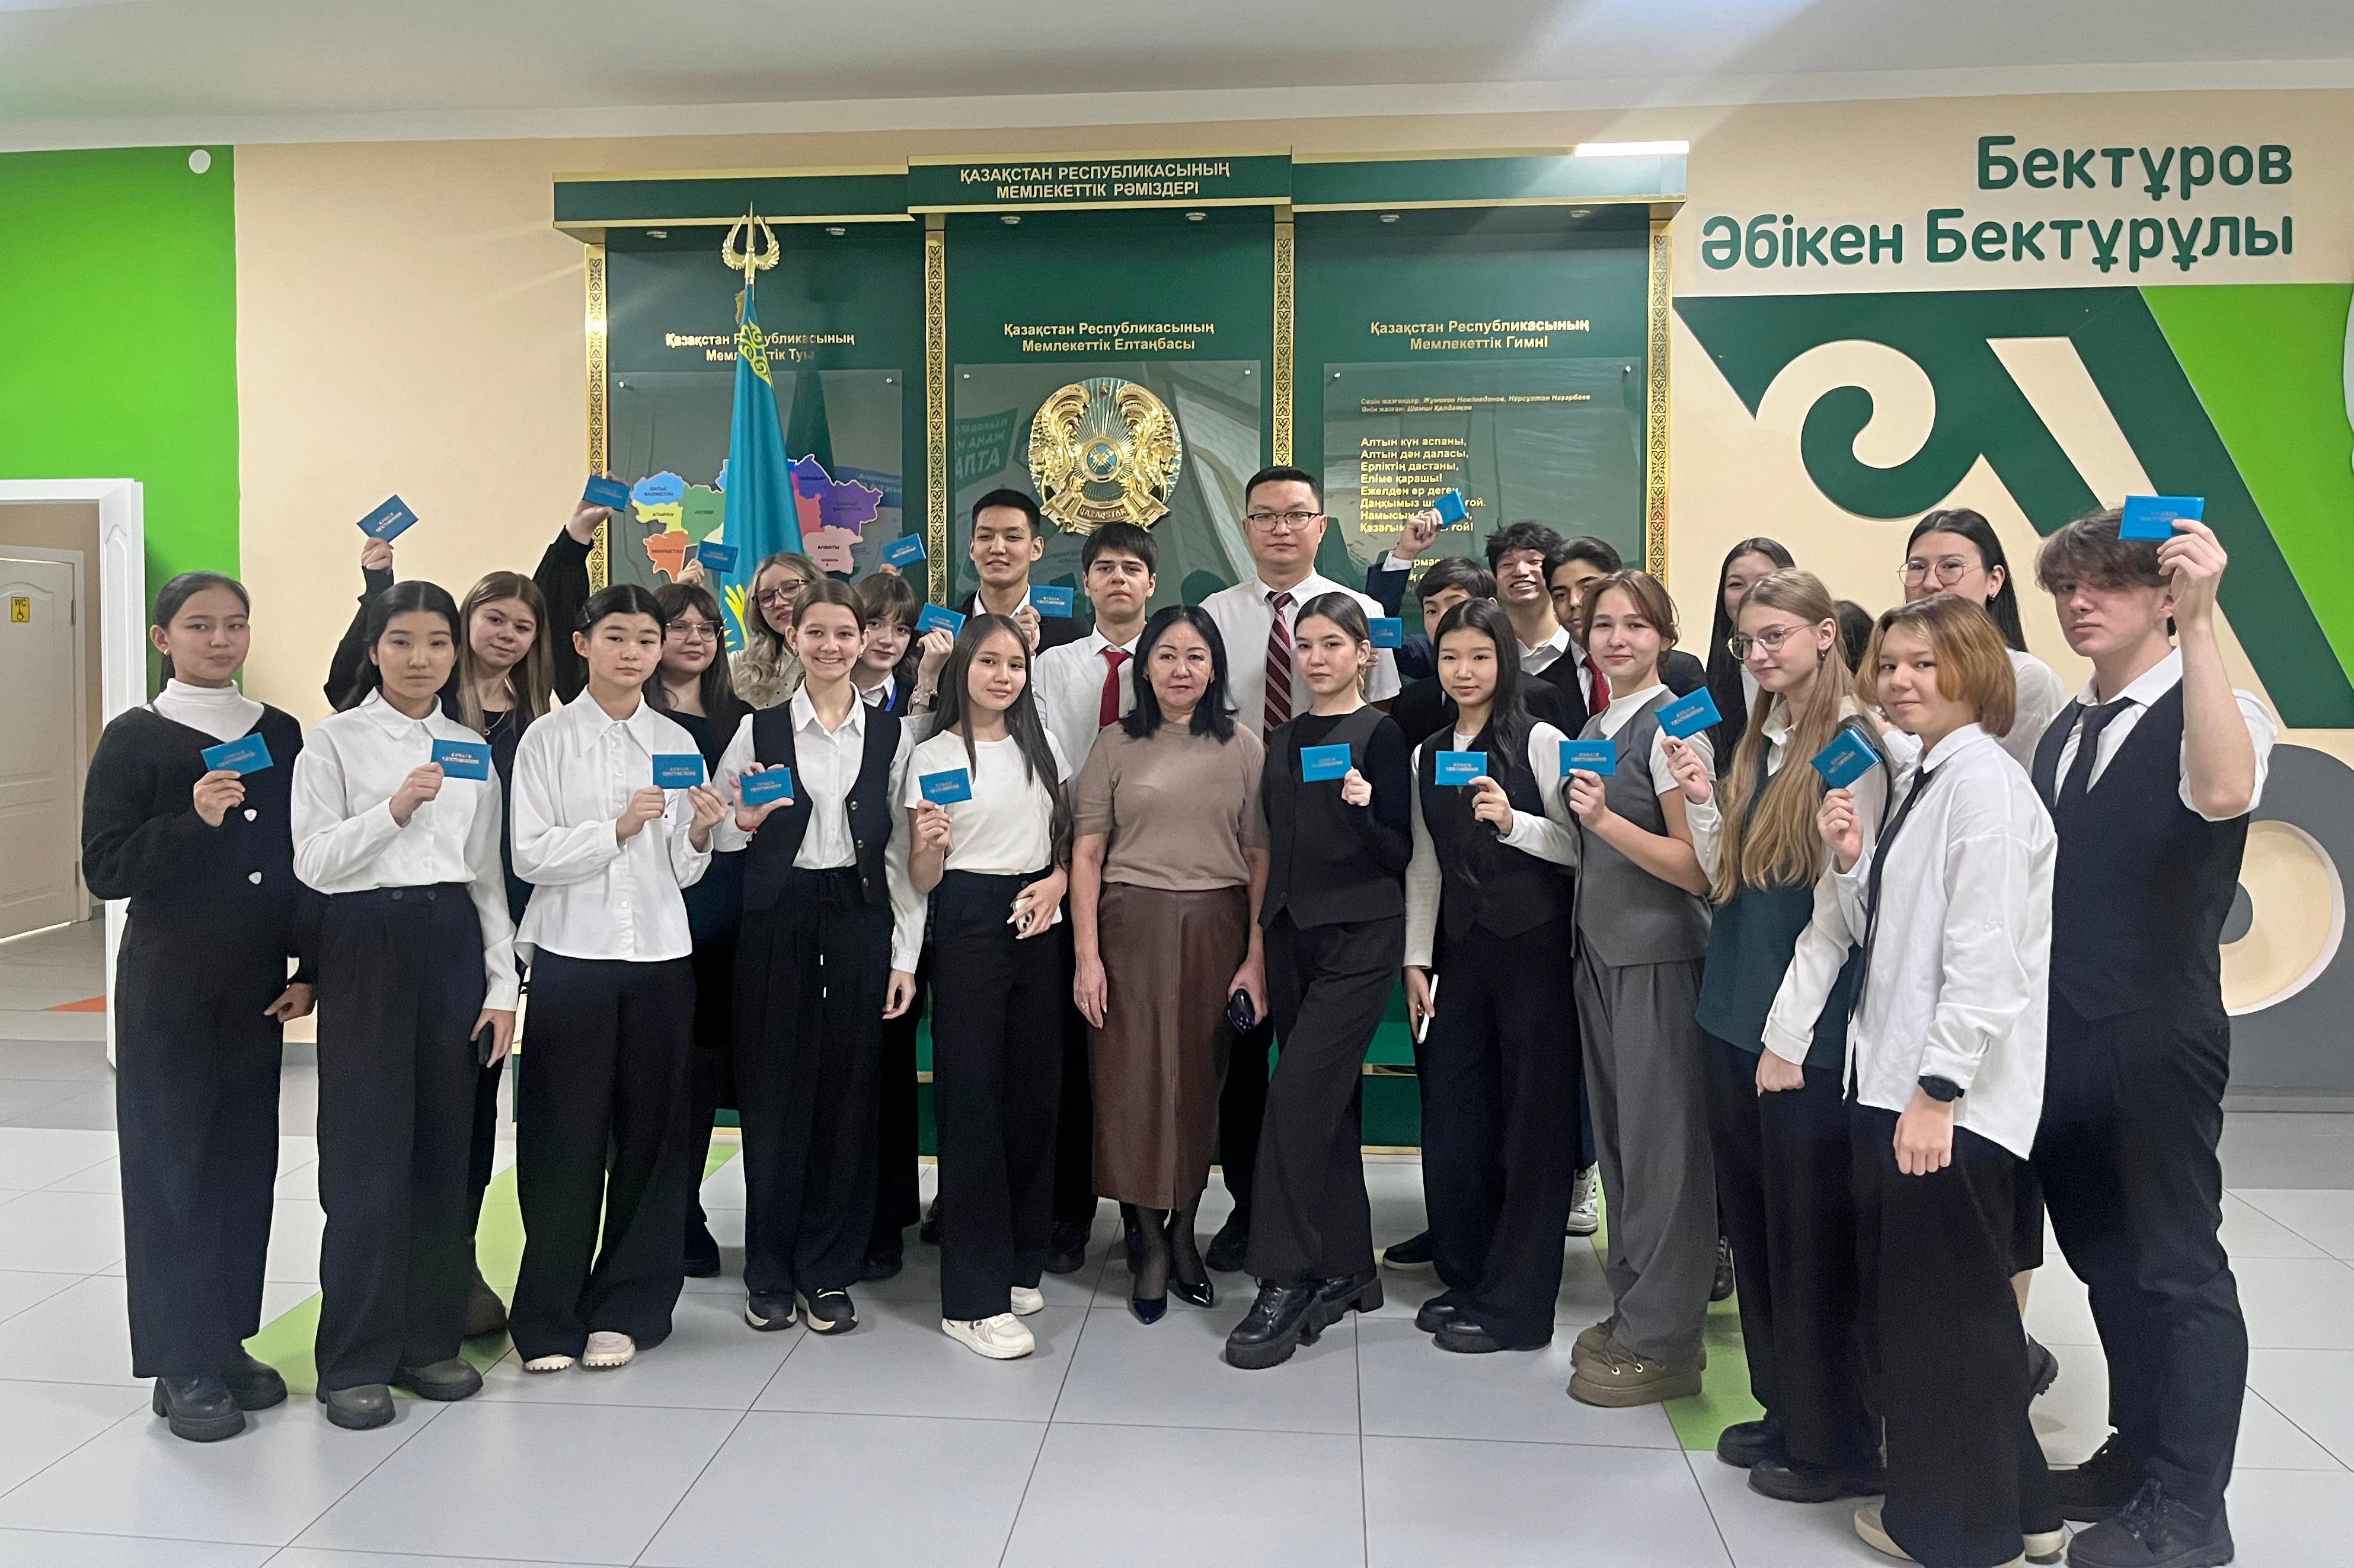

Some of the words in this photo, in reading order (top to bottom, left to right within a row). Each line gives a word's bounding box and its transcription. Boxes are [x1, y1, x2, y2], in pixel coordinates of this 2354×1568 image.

[960, 168, 1052, 184] ҚАЗАҚСТАН
[1058, 162, 1230, 180] РЕСПУБЛИКАСЫНЫҢ
[1978, 135, 2292, 200] Бектұров
[996, 184, 1106, 199] МЕМЛЕКЕТТІК
[1114, 181, 1199, 198] РӘМІЗДЕРІ
[1701, 213, 1903, 270] Әбікен
[1927, 208, 2292, 273] Бектұрұлы
[1004, 323, 1074, 338] Қазақстан
[1079, 321, 1215, 336] Республикасының
[1371, 322, 1443, 336] Қазақстан
[1449, 319, 1590, 335] Республикасының
[665, 333, 730, 348] Қазақстан
[733, 332, 855, 347] Рубликасының
[1023, 338, 1110, 352] Мемлекеттік
[1114, 337, 1195, 352] Елтаңбасы
[1410, 336, 1502, 350] Мемлекеттік
[1506, 336, 1548, 349] Гимні
[788, 349, 815, 363] Туы
[1360, 437, 1398, 446] Алтын
[1400, 439, 1419, 448] күн
[1422, 438, 1467, 446] аспаны,
[1360, 449, 1398, 459] Алтын
[1400, 451, 1420, 459] дән
[1423, 450, 1469, 459] даласы,
[1360, 462, 1406, 472] Ерліктің
[1408, 463, 1459, 472] дастаны,
[1360, 474, 1393, 484] Еліме
[1395, 473, 1442, 484] қарашы!
[1360, 486, 1409, 497] Ежелден
[1411, 487, 1425, 497] ер
[1360, 499, 1420, 509] Даңқымыз
